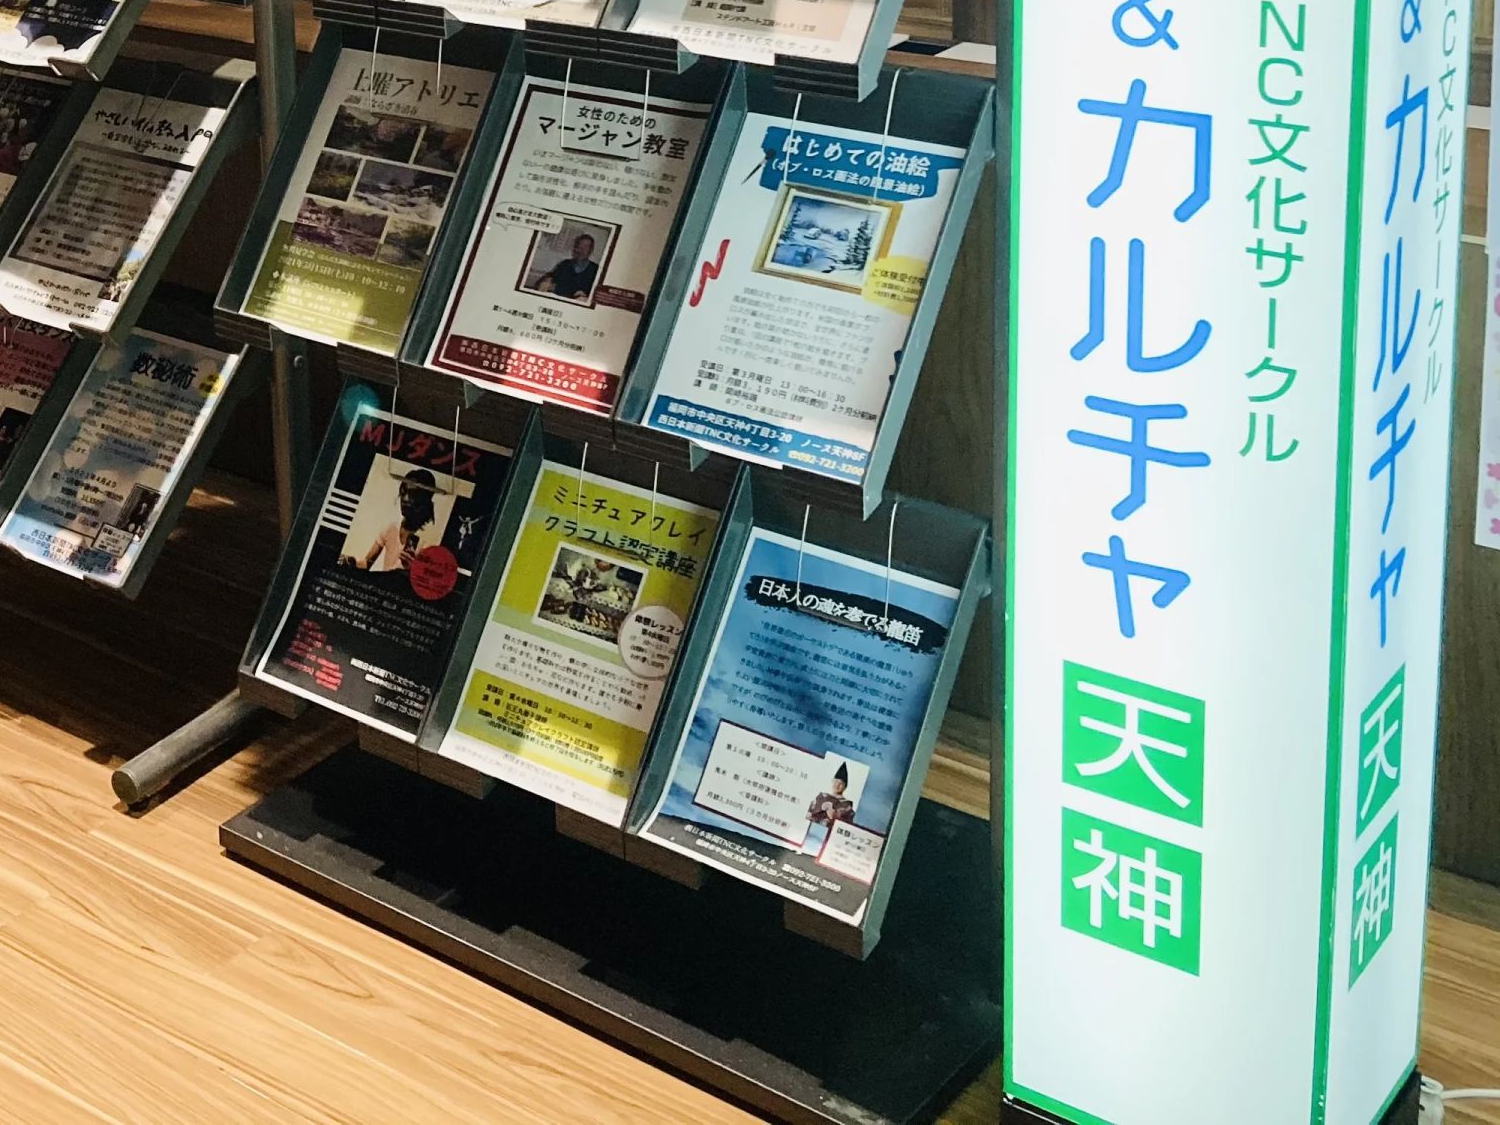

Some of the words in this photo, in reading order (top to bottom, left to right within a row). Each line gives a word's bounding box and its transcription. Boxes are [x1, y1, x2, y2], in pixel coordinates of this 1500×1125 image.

[352, 67, 480, 109] 土曜アトリエ
[538, 115, 690, 161] マージャン教室
[576, 104, 657, 130] 女性のための
[782, 135, 932, 178] はじめての油絵
[131, 350, 200, 390] 数秘術
[657, 414, 781, 455] 西日本新聞TNC文化サークル
[666, 401, 793, 444] 福岡市中央区天神4丁目3-20
[359, 419, 482, 476] MJダンス
[553, 485, 707, 547] ミニチュアクレイ
[544, 515, 698, 579] クラフト認定講座
[758, 578, 924, 647] 日本人の魂を奏でる龍笛
[1072, 678, 1194, 952] 天神
